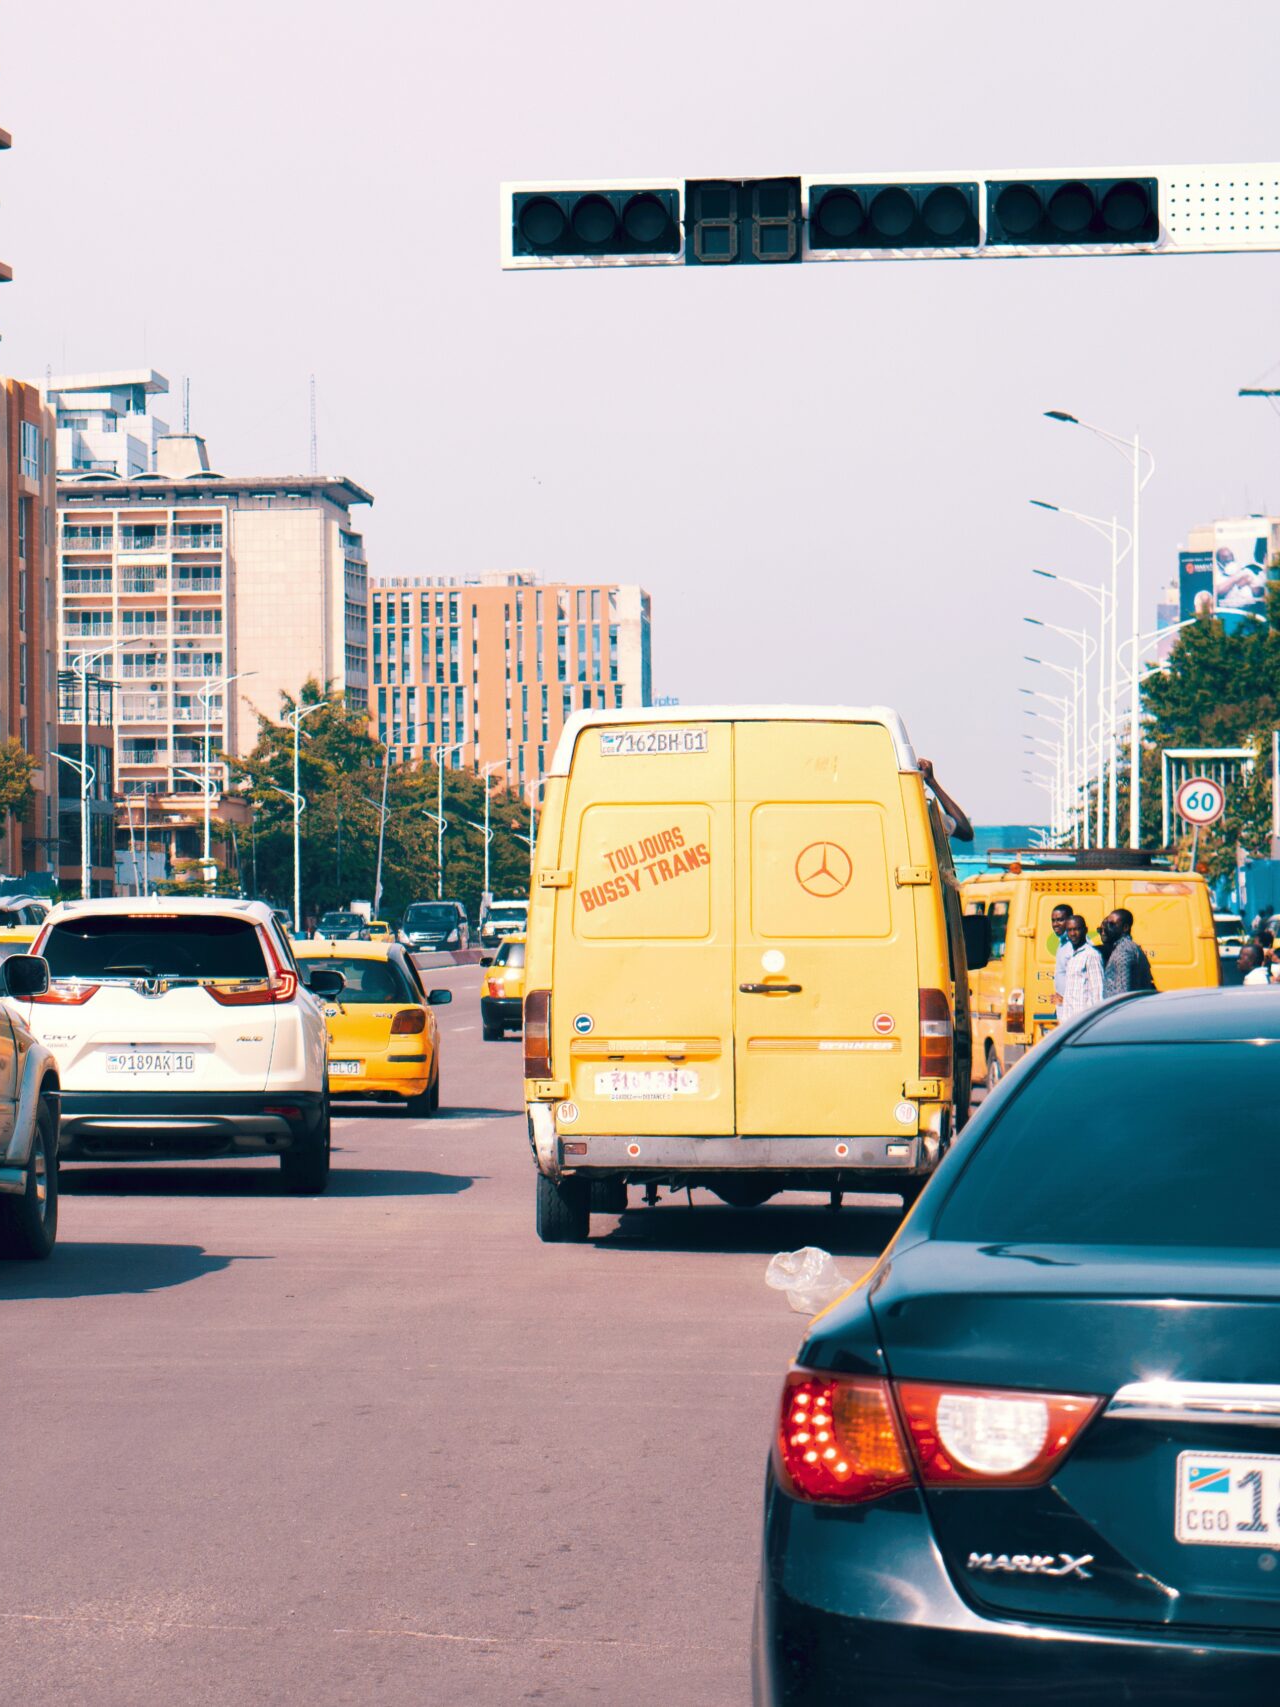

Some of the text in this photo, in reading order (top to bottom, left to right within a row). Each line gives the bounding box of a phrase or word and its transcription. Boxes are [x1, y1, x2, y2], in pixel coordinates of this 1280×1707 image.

[1186, 791, 1214, 812] 60
[604, 826, 685, 874] TOUJOURS
[579, 843, 711, 913] BUSSY TRANS
[118, 1055, 171, 1070] 9189AK
[176, 1055, 193, 1070] 10
[561, 1104, 574, 1118] 60
[1186, 1509, 1229, 1531] CGO
